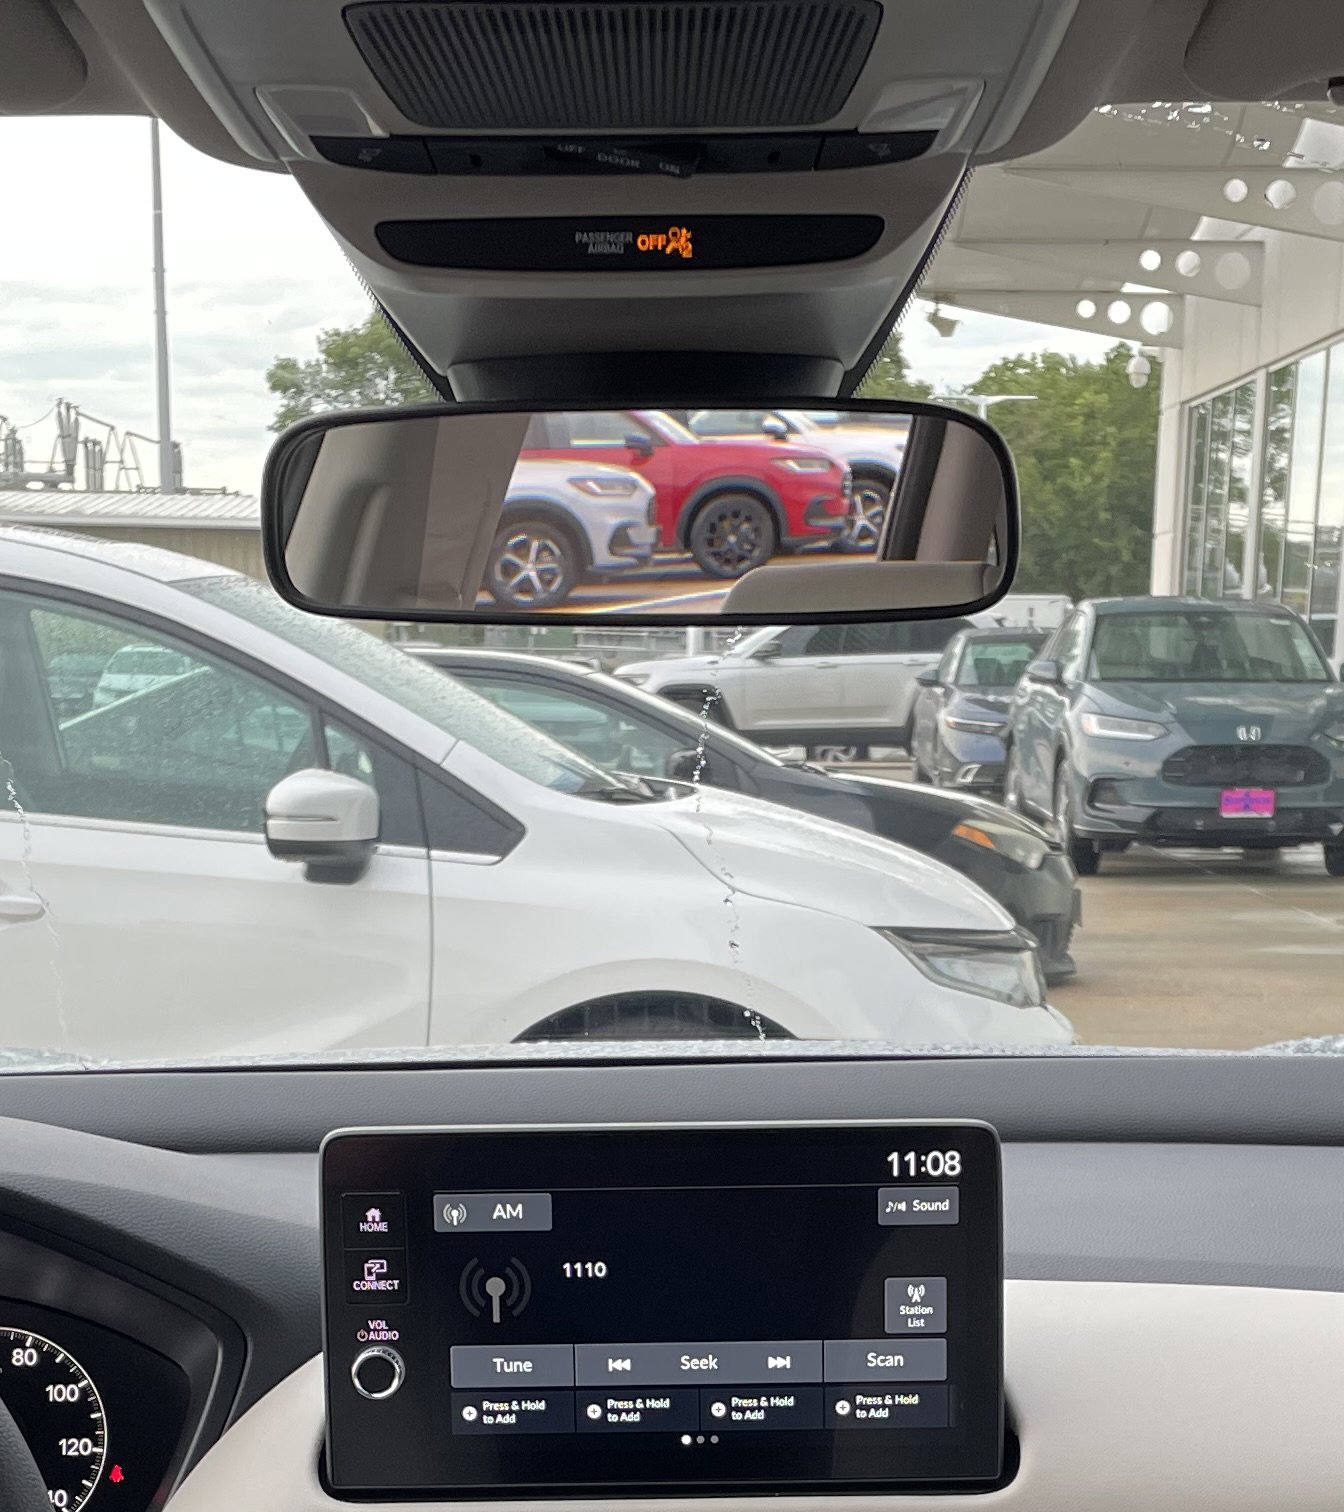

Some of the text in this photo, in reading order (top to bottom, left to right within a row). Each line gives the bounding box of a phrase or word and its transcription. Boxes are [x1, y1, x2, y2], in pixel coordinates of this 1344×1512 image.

[637, 234, 667, 251] OFF
[887, 1150, 961, 1177] 11:08
[912, 1199, 950, 1211] Sound
[493, 1203, 523, 1220] AM
[359, 1222, 388, 1232] HOME
[563, 1261, 607, 1278] 1110
[353, 1280, 399, 1290] CONNECT
[899, 1305, 934, 1315] Station
[368, 1320, 388, 1330] VOL
[908, 1318, 925, 1327] List
[368, 1330, 399, 1340] AUDIO
[12, 1349, 37, 1367] 80
[680, 1355, 719, 1370] Seek
[867, 1352, 905, 1367] Scan
[492, 1358, 533, 1373] Tune
[46, 1384, 79, 1402] 100
[607, 1398, 670, 1409] Press & Hold
[731, 1396, 794, 1407] Press & Hold
[856, 1394, 919, 1405] Press & Hold
[482, 1400, 545, 1411] Press & Hold
[607, 1412, 640, 1422] to Add
[731, 1410, 765, 1420] to Add
[856, 1408, 889, 1418] to Add
[483, 1414, 516, 1424] to Add
[59, 1438, 92, 1456] 120
